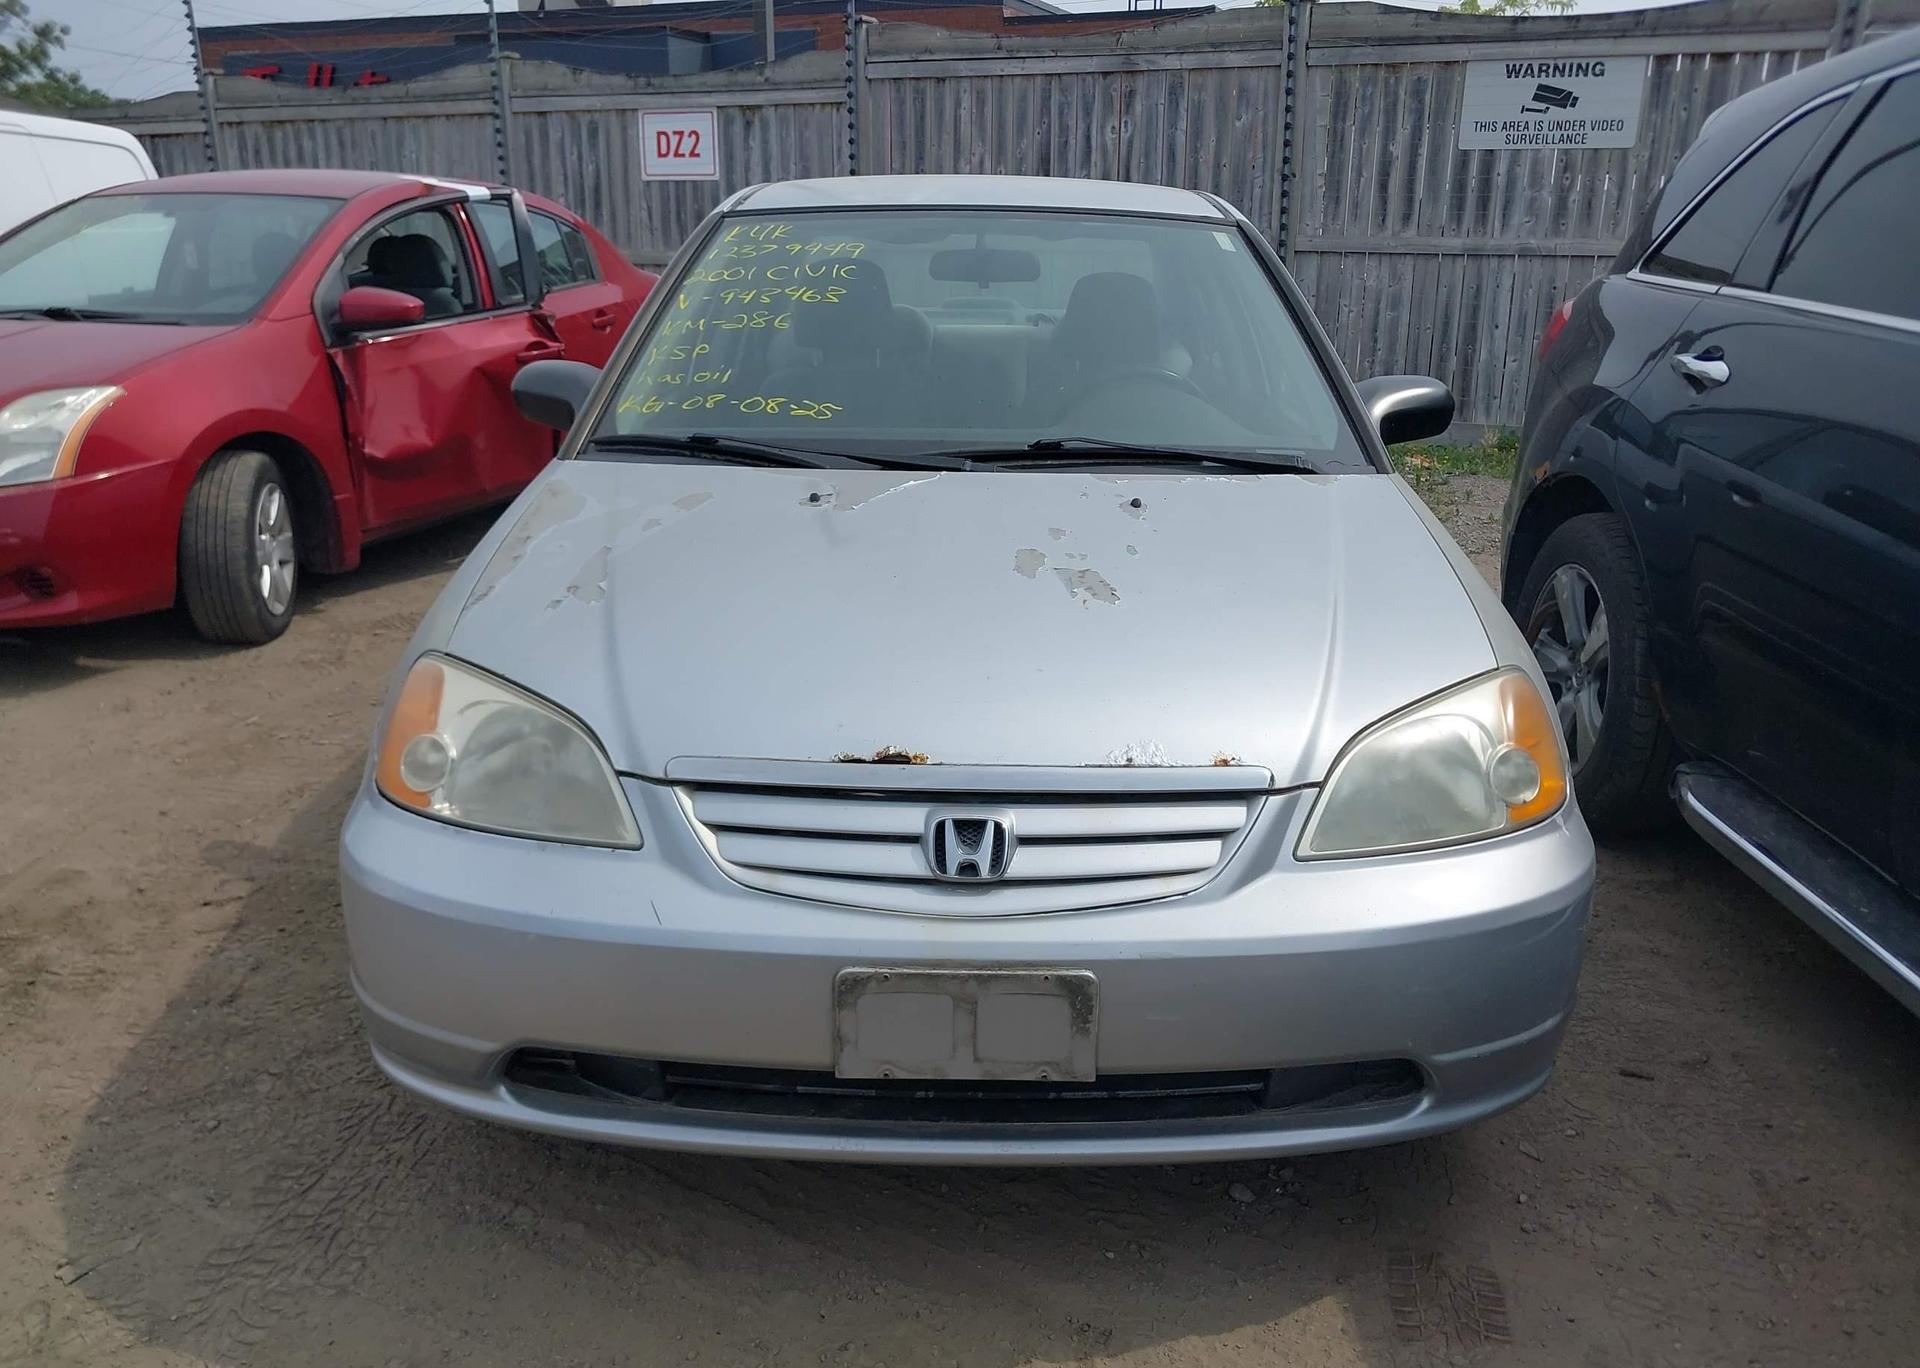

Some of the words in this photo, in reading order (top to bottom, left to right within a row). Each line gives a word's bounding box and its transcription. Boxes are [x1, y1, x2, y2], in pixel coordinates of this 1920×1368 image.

[1505, 61, 1606, 79] WARNING
[1473, 120, 1498, 133] THIS
[1501, 120, 1530, 132] AREA
[1533, 120, 1544, 132] IS
[1547, 120, 1586, 132] UNDER
[1590, 119, 1625, 131] VIDEO
[656, 130, 701, 158] DZ2
[1504, 133, 1589, 145] SURVEILLANCE
[684, 265, 756, 285] 2001
[766, 263, 859, 280] CIVIC
